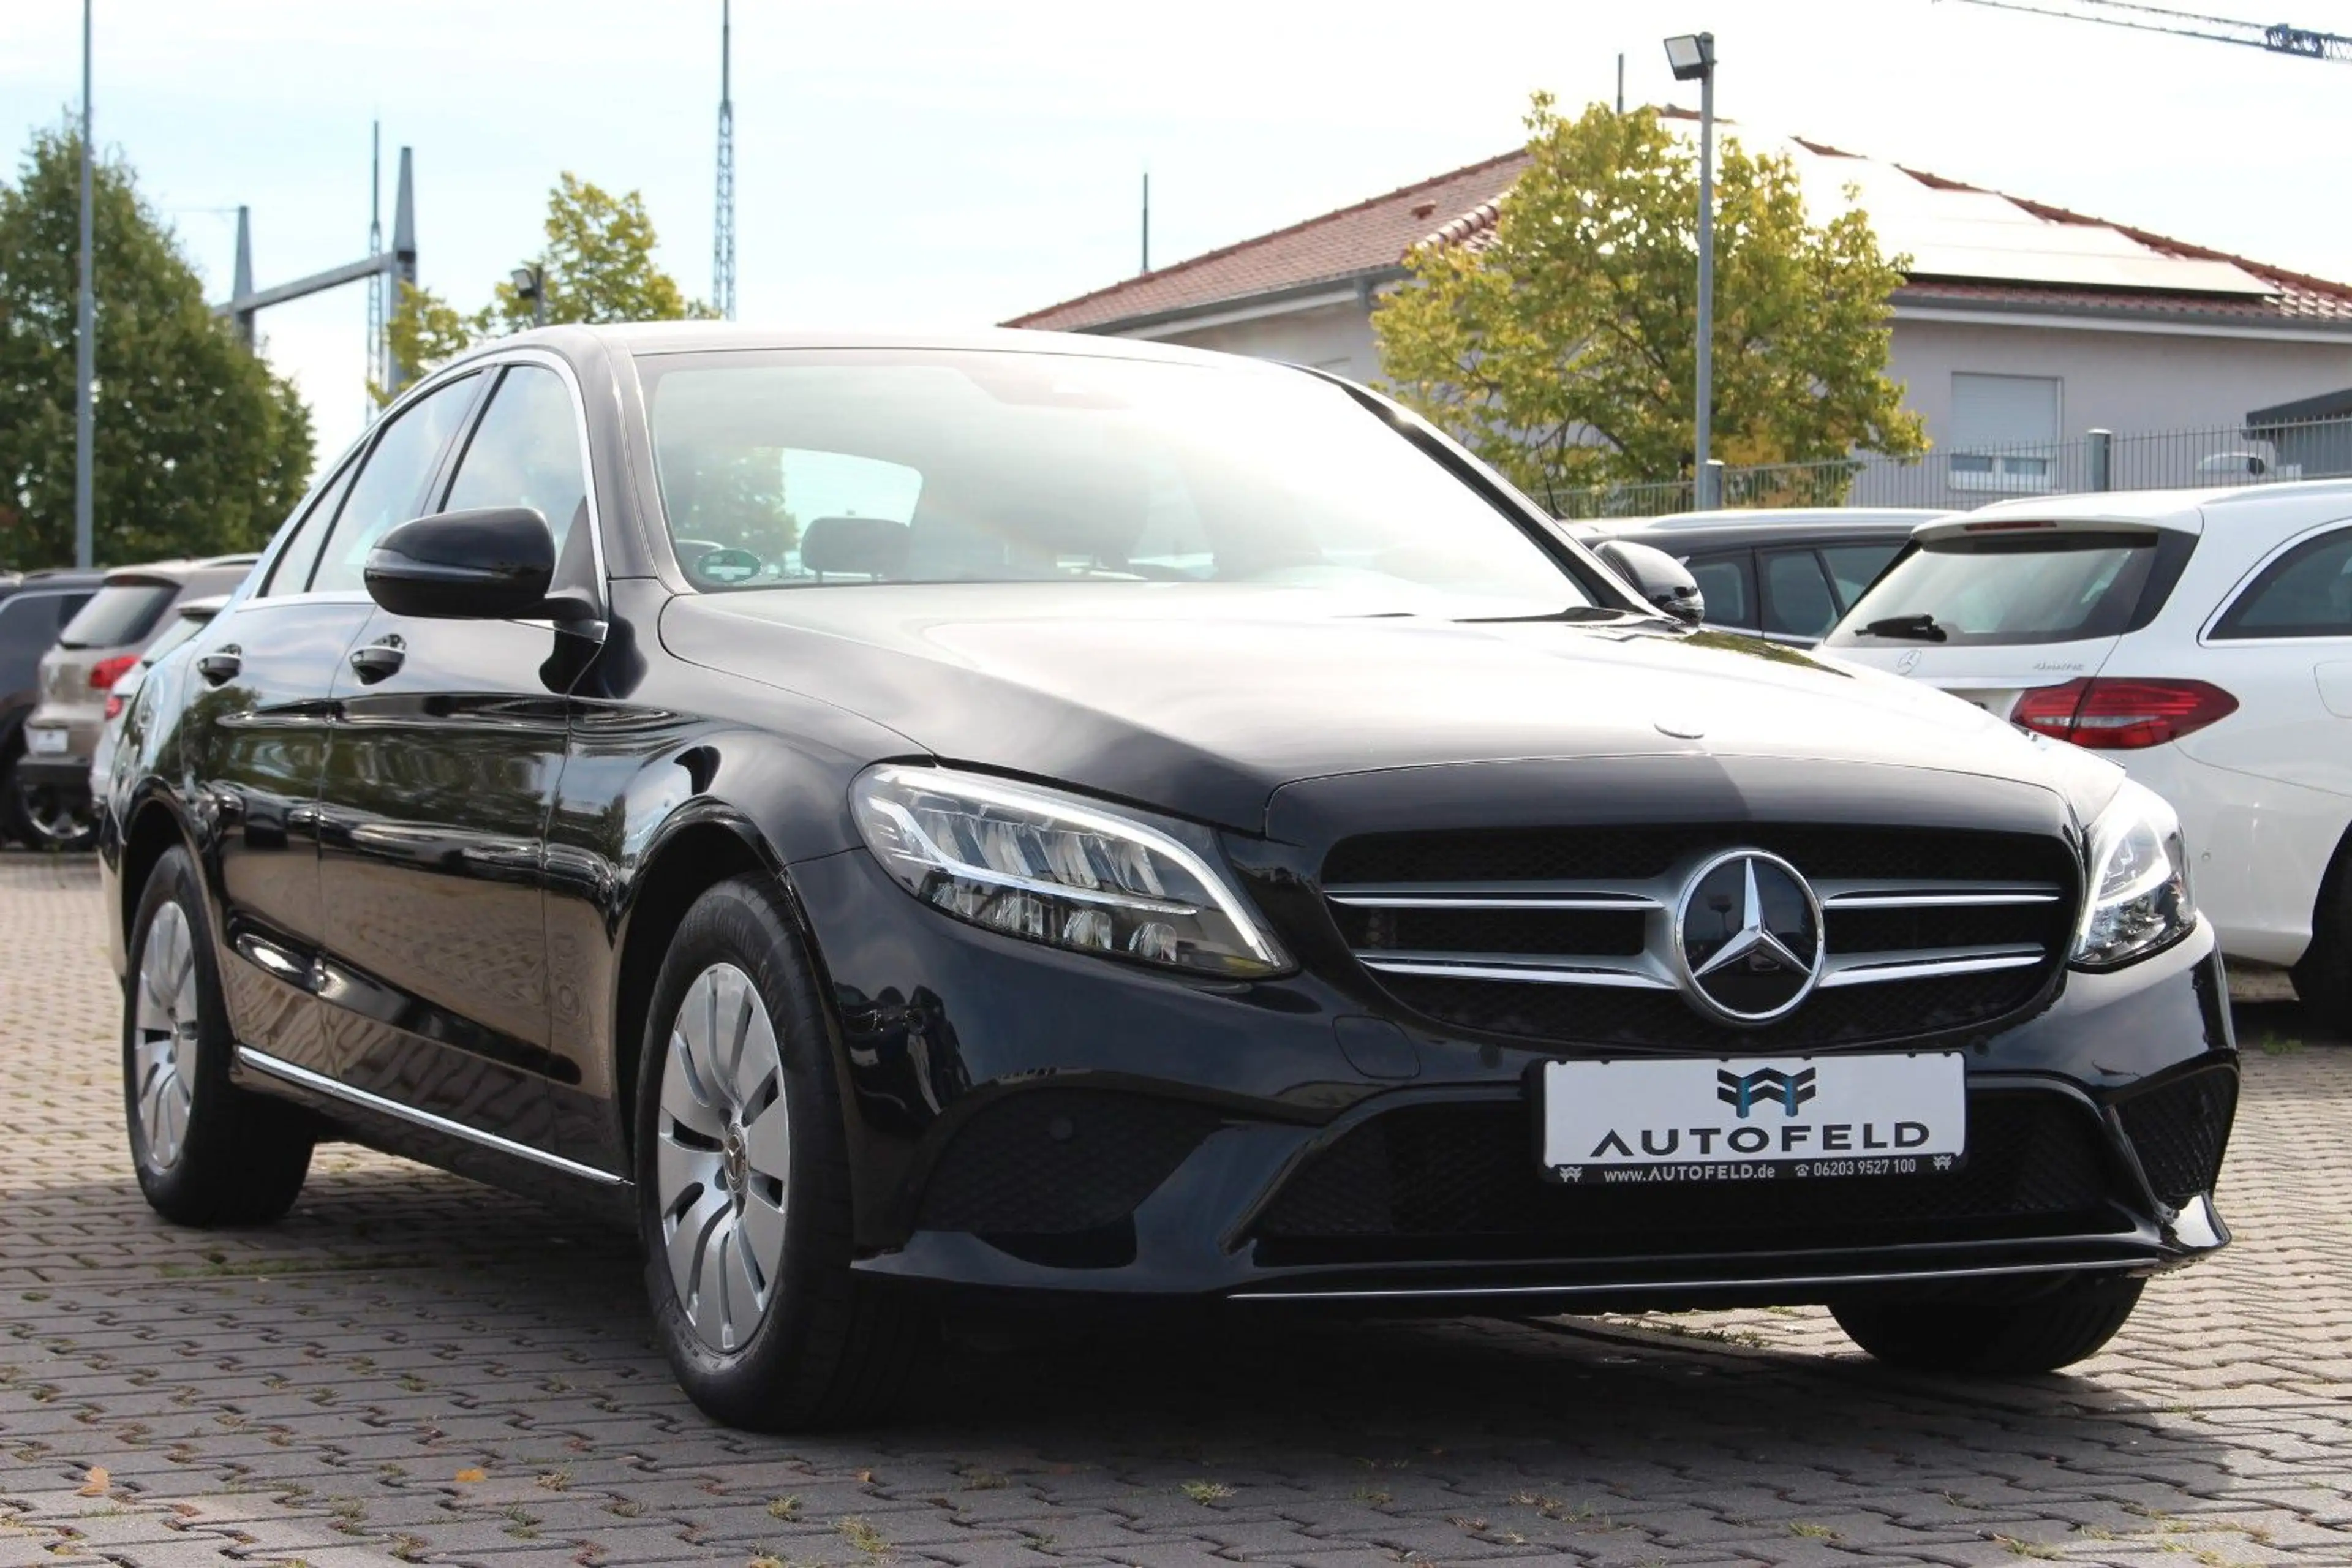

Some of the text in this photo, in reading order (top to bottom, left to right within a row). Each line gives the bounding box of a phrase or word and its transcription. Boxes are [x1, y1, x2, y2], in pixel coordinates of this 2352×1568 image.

[1590, 1121, 1929, 1158] AUTOFELD
[1604, 1159, 1917, 1182] www.AUTOFELD.de 06203 9527 100
